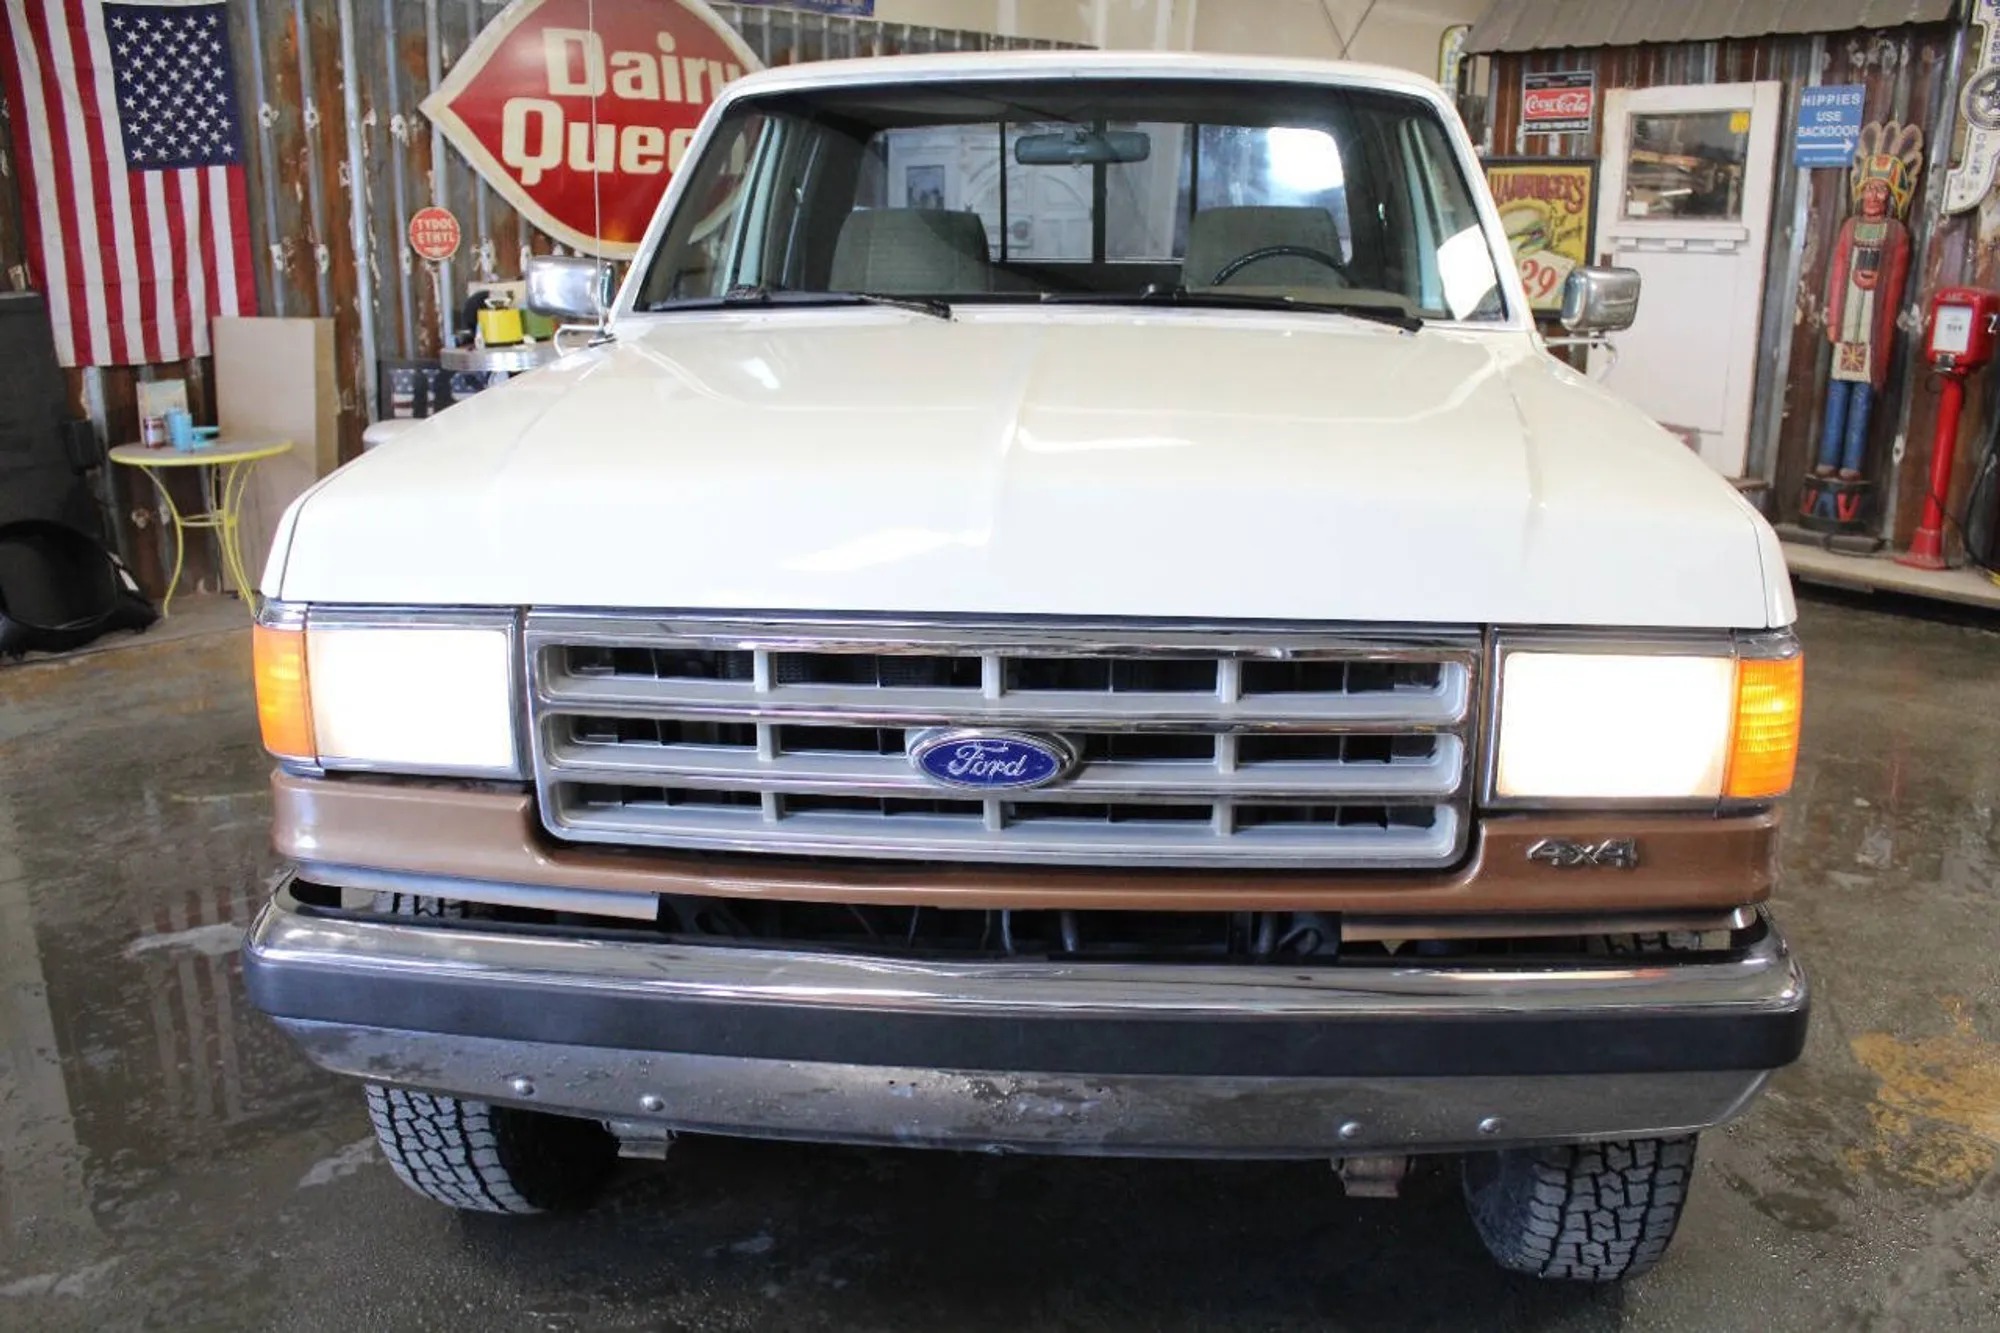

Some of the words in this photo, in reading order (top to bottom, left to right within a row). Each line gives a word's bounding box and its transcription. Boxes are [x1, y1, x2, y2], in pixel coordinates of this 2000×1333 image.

[1801, 93, 1860, 107] HIPPIES
[1816, 110, 1842, 122] USE
[1797, 124, 1860, 137] BACKDOOR
[947, 742, 1028, 782] Ford
